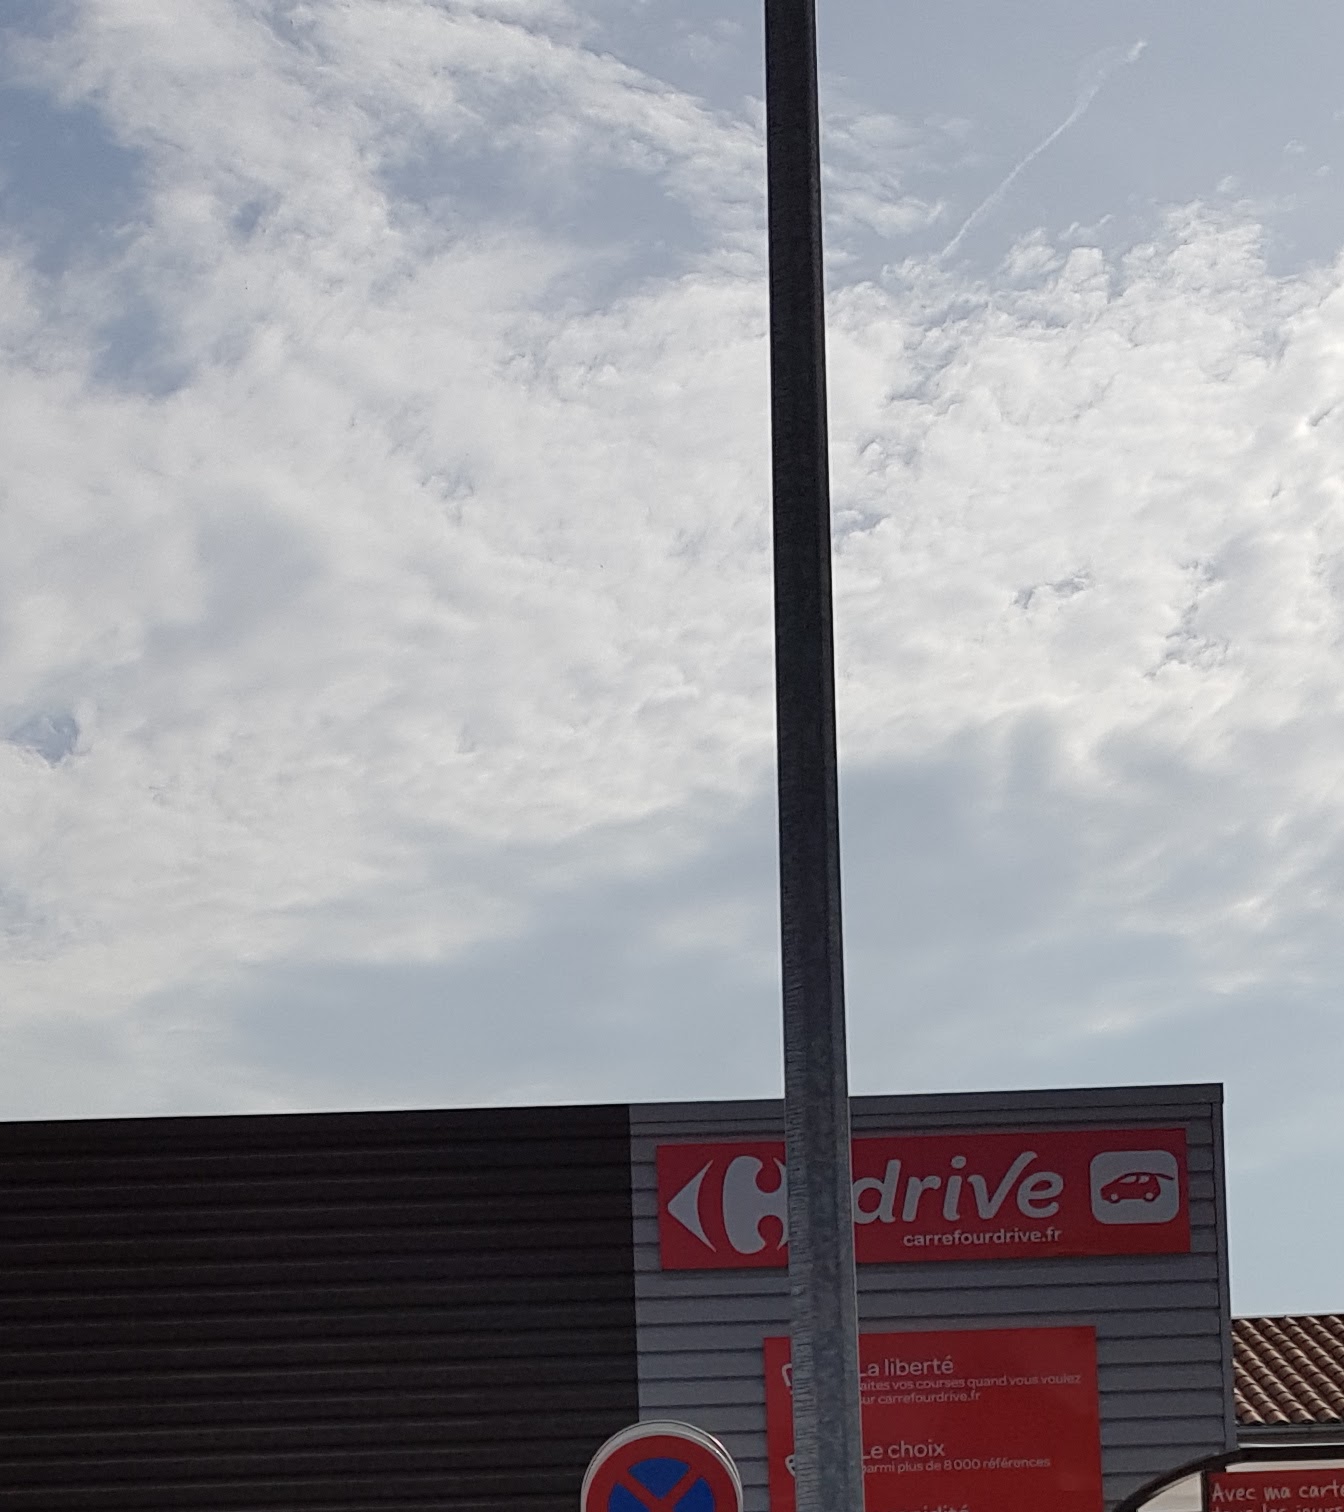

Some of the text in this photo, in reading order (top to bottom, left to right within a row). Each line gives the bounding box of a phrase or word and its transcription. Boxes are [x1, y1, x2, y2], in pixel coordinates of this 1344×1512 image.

[852, 1151, 1065, 1224] drive
[903, 1226, 1063, 1248] carrefourdrive.fr
[885, 1355, 955, 1377] liberté
[892, 1379, 913, 1390] vos
[915, 1378, 965, 1390] courses
[967, 1375, 1007, 1389] quand
[860, 1390, 981, 1405] ur carrefourdrive.fr
[888, 1439, 945, 1459] choix
[897, 1460, 923, 1474] plus
[926, 1459, 941, 1471] de
[1212, 1482, 1256, 1502] Avec
[1264, 1486, 1291, 1501] ma
